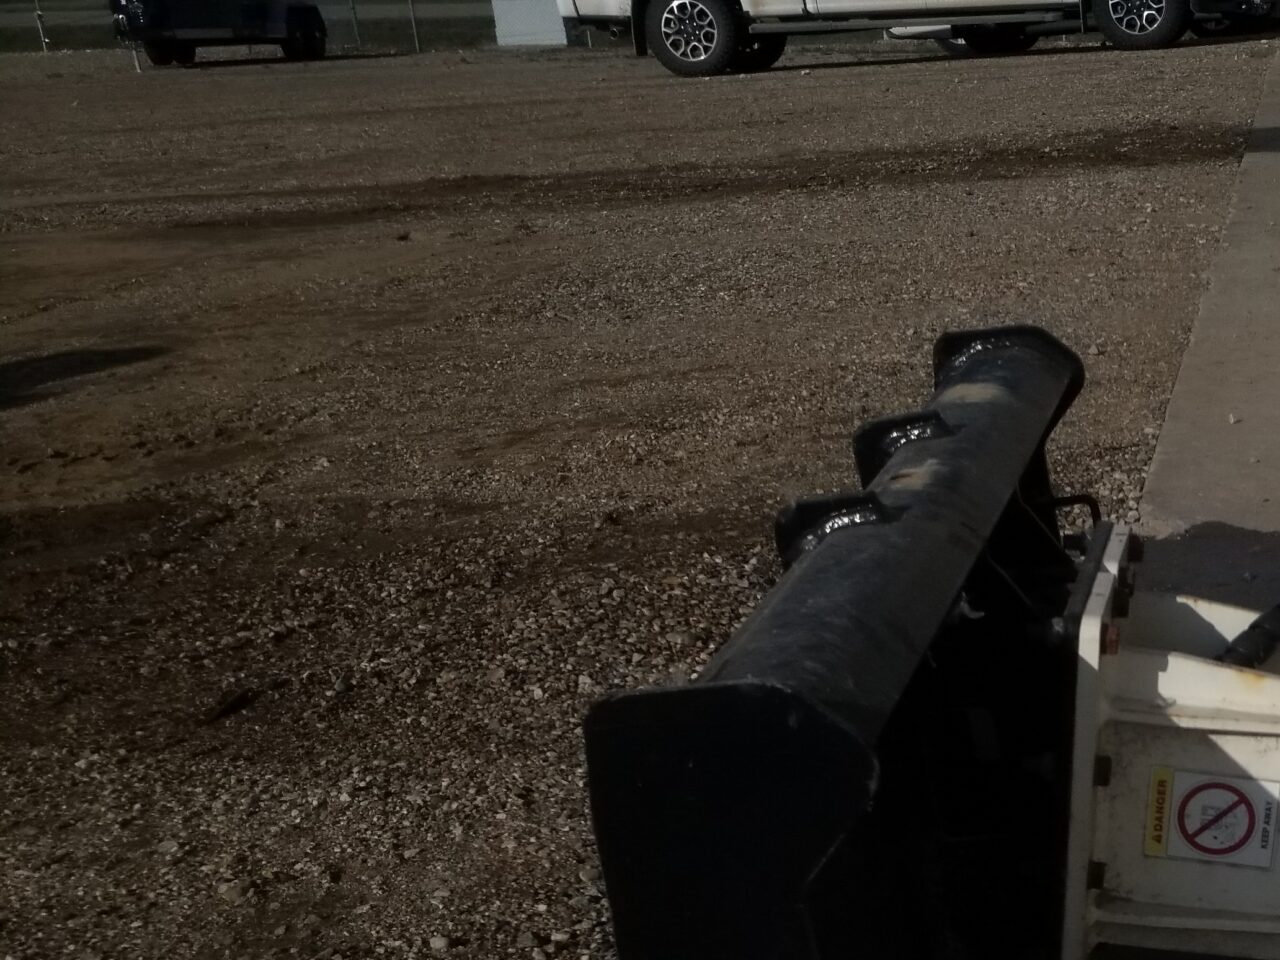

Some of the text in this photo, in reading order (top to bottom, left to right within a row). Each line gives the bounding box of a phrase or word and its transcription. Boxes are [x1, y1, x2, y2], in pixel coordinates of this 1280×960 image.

[1154, 780, 1168, 831] DANGER
[1261, 801, 1272, 849] KEEP AWAY
